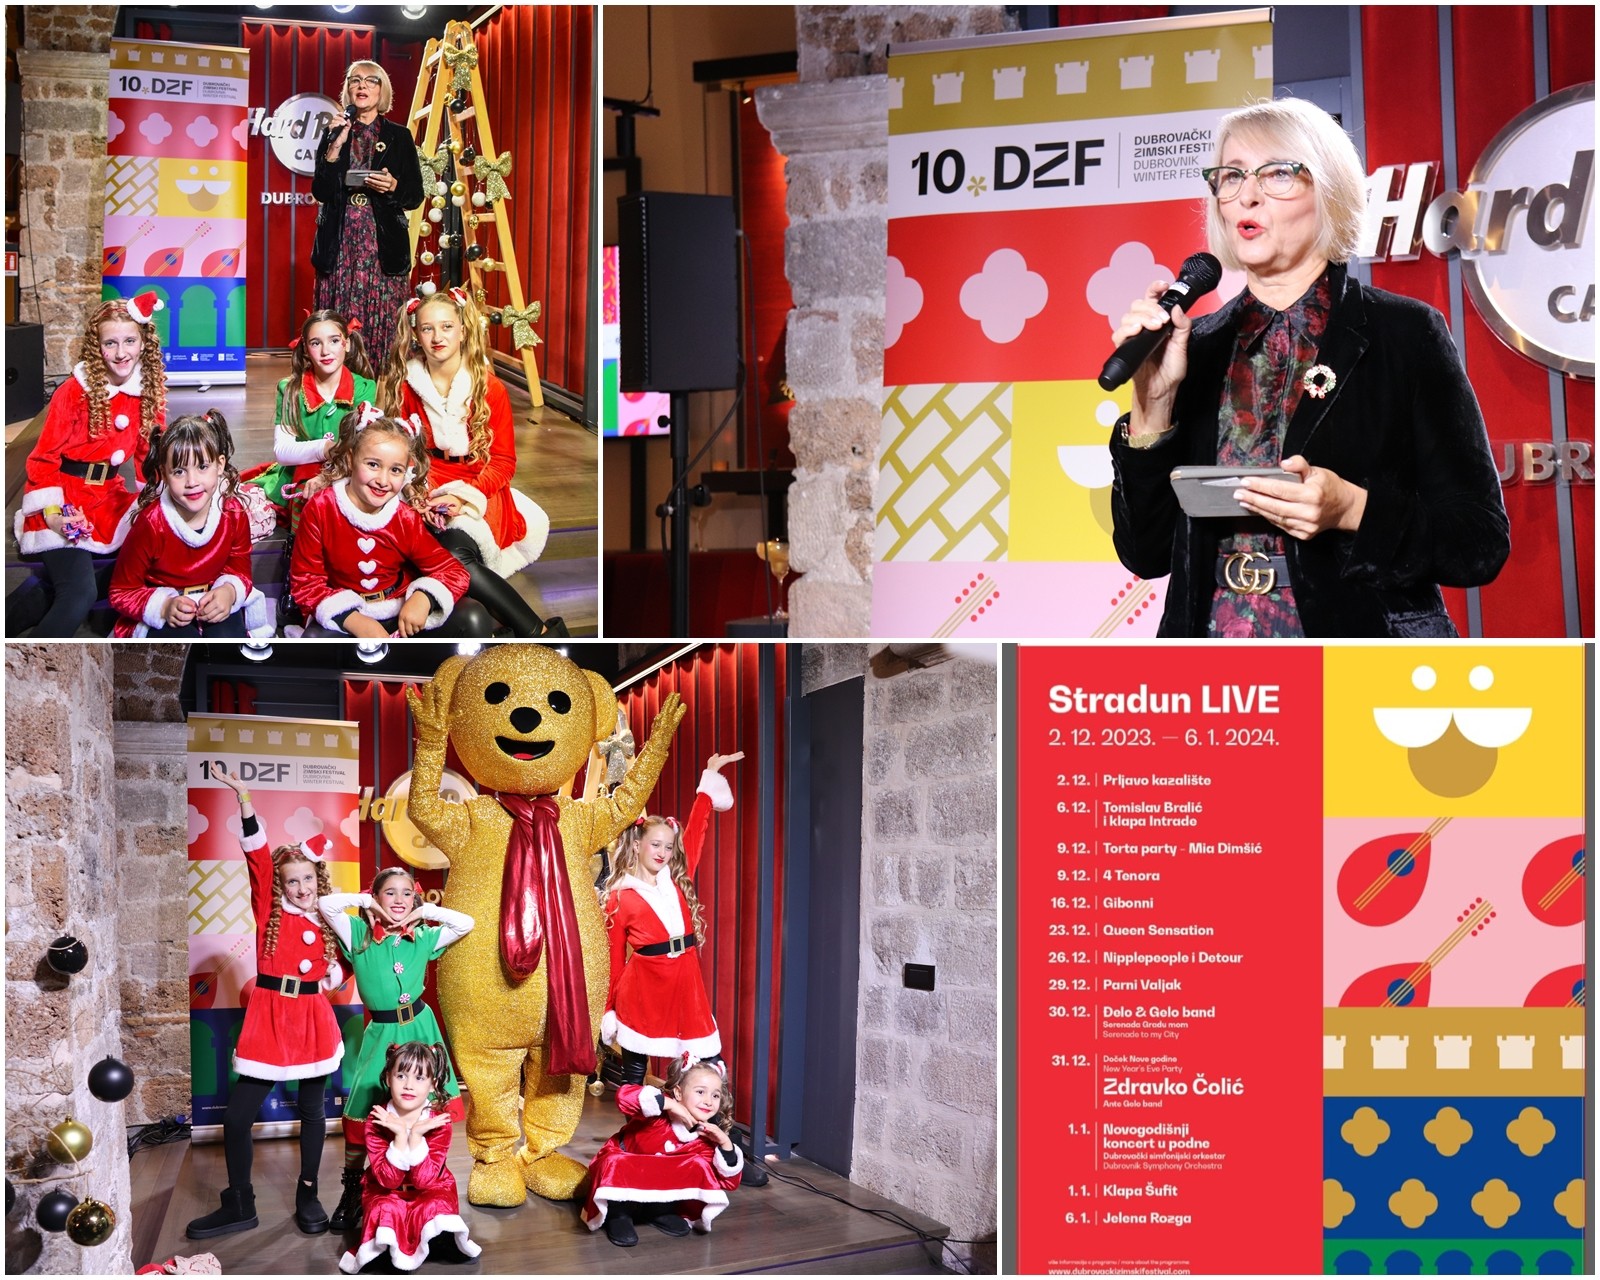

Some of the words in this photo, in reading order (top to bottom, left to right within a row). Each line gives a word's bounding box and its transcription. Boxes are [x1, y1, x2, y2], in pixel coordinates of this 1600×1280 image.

[151, 77, 193, 96] DZF
[1134, 128, 1212, 146] DUBROVAČKI
[295, 149, 318, 160] CA
[1133, 146, 1177, 158] ZIMSKI
[993, 138, 1105, 192] DZF
[1133, 155, 1200, 171] DUBROVNIK
[1133, 169, 1178, 183] WINTER
[1179, 167, 1204, 179] FES
[261, 192, 315, 205] DUBRO
[1355, 150, 1595, 260] Hard
[1049, 684, 1191, 713] Stradun
[1202, 684, 1280, 713] LIVE
[1049, 728, 1066, 746] 2.
[1071, 728, 1096, 746] 12.
[1101, 728, 1156, 746] 2023.
[1184, 728, 1202, 746] 6.
[1208, 728, 1220, 746] 1.
[1225, 728, 1280, 746] 2024.
[240, 761, 291, 782] DZF
[1057, 774, 1070, 786] 2.
[1072, 774, 1091, 786] 12.
[1103, 774, 1149, 788] Prljavo
[1152, 774, 1211, 786] kazalište
[1057, 801, 1070, 813] 6.
[1072, 801, 1091, 813] 12.
[1103, 801, 1161, 813] Tomislav
[1164, 801, 1203, 813] Bralić
[1103, 815, 1106, 826] i
[1109, 815, 1146, 829] klapa
[1149, 815, 1197, 826] Intrade
[1057, 842, 1070, 854] 9.
[1072, 842, 1091, 854] 12.
[1103, 842, 1138, 854] Torta
[1141, 843, 1177, 857] party
[1189, 842, 1215, 854] Mia
[1218, 842, 1263, 854] Dimšić
[1057, 869, 1070, 881] 9.
[1072, 869, 1091, 881] 12.
[1103, 869, 1112, 881] 4
[1115, 869, 1160, 881] Tenora
[1051, 897, 1070, 909] 16.
[1072, 897, 1091, 909] 12.
[1103, 897, 1154, 909] Gibonni
[1049, 924, 1070, 936] 23.
[1072, 924, 1091, 936] 12.
[1103, 924, 1145, 937] Queen
[1148, 924, 1214, 936] Sensation
[1048, 951, 1070, 963] 26.
[1072, 951, 1091, 963] 12.
[1103, 951, 1189, 966] Nipplepeople
[1192, 951, 1195, 963] i
[1198, 951, 1243, 963] Detour
[1049, 979, 1070, 991] 29.
[1072, 979, 1091, 991] 12.
[1103, 978, 1137, 990] Parni
[1140, 978, 1181, 993] Valjak
[1049, 1006, 1070, 1018] 30.
[1072, 1006, 1091, 1018] 12.
[1135, 1006, 1146, 1018] &
[1149, 1006, 1179, 1018] Gelo
[1182, 1006, 1215, 1018] band
[1103, 1020, 1140, 1028] Serenada
[1142, 1020, 1166, 1028] Gradu
[1168, 1020, 1188, 1028] mom
[1163, 1031, 1179, 1039] City
[1052, 1055, 1070, 1067] 31.
[1072, 1055, 1091, 1067] 12.
[1103, 1055, 1128, 1063] Doček
[1129, 1055, 1149, 1063] Nove
[1151, 1055, 1177, 1064] godine
[1103, 1077, 1188, 1095] Zdravko
[1192, 1073, 1244, 1095] Čolić
[1103, 1100, 1121, 1108] Ante
[1123, 1100, 1141, 1108] Gelo
[1142, 1100, 1163, 1108] band
[1068, 1123, 1079, 1135] 1.
[1081, 1123, 1091, 1135] 1.
[1103, 1123, 1189, 1138] Novogodišnji
[1103, 1137, 1155, 1149] koncert
[1158, 1141, 1166, 1149] u
[1169, 1137, 1210, 1151] podne
[1103, 1152, 1148, 1160] Dubrovački
[1149, 1152, 1191, 1161] simfonijski
[1192, 1152, 1226, 1160] orkestar
[1143, 1162, 1182, 1171] Symphony
[1068, 1185, 1079, 1197] 1.
[1081, 1185, 1091, 1197] 1.
[1103, 1184, 1142, 1199] Klapa
[1145, 1182, 1178, 1196] Šufit
[1065, 1212, 1079, 1224] 6.
[1081, 1212, 1091, 1224] 1.
[1103, 1212, 1147, 1224] Jelena
[1150, 1212, 1191, 1226] Rozga
[1048, 1267, 1191, 1275] www.dubrovackizimskifestival.com
